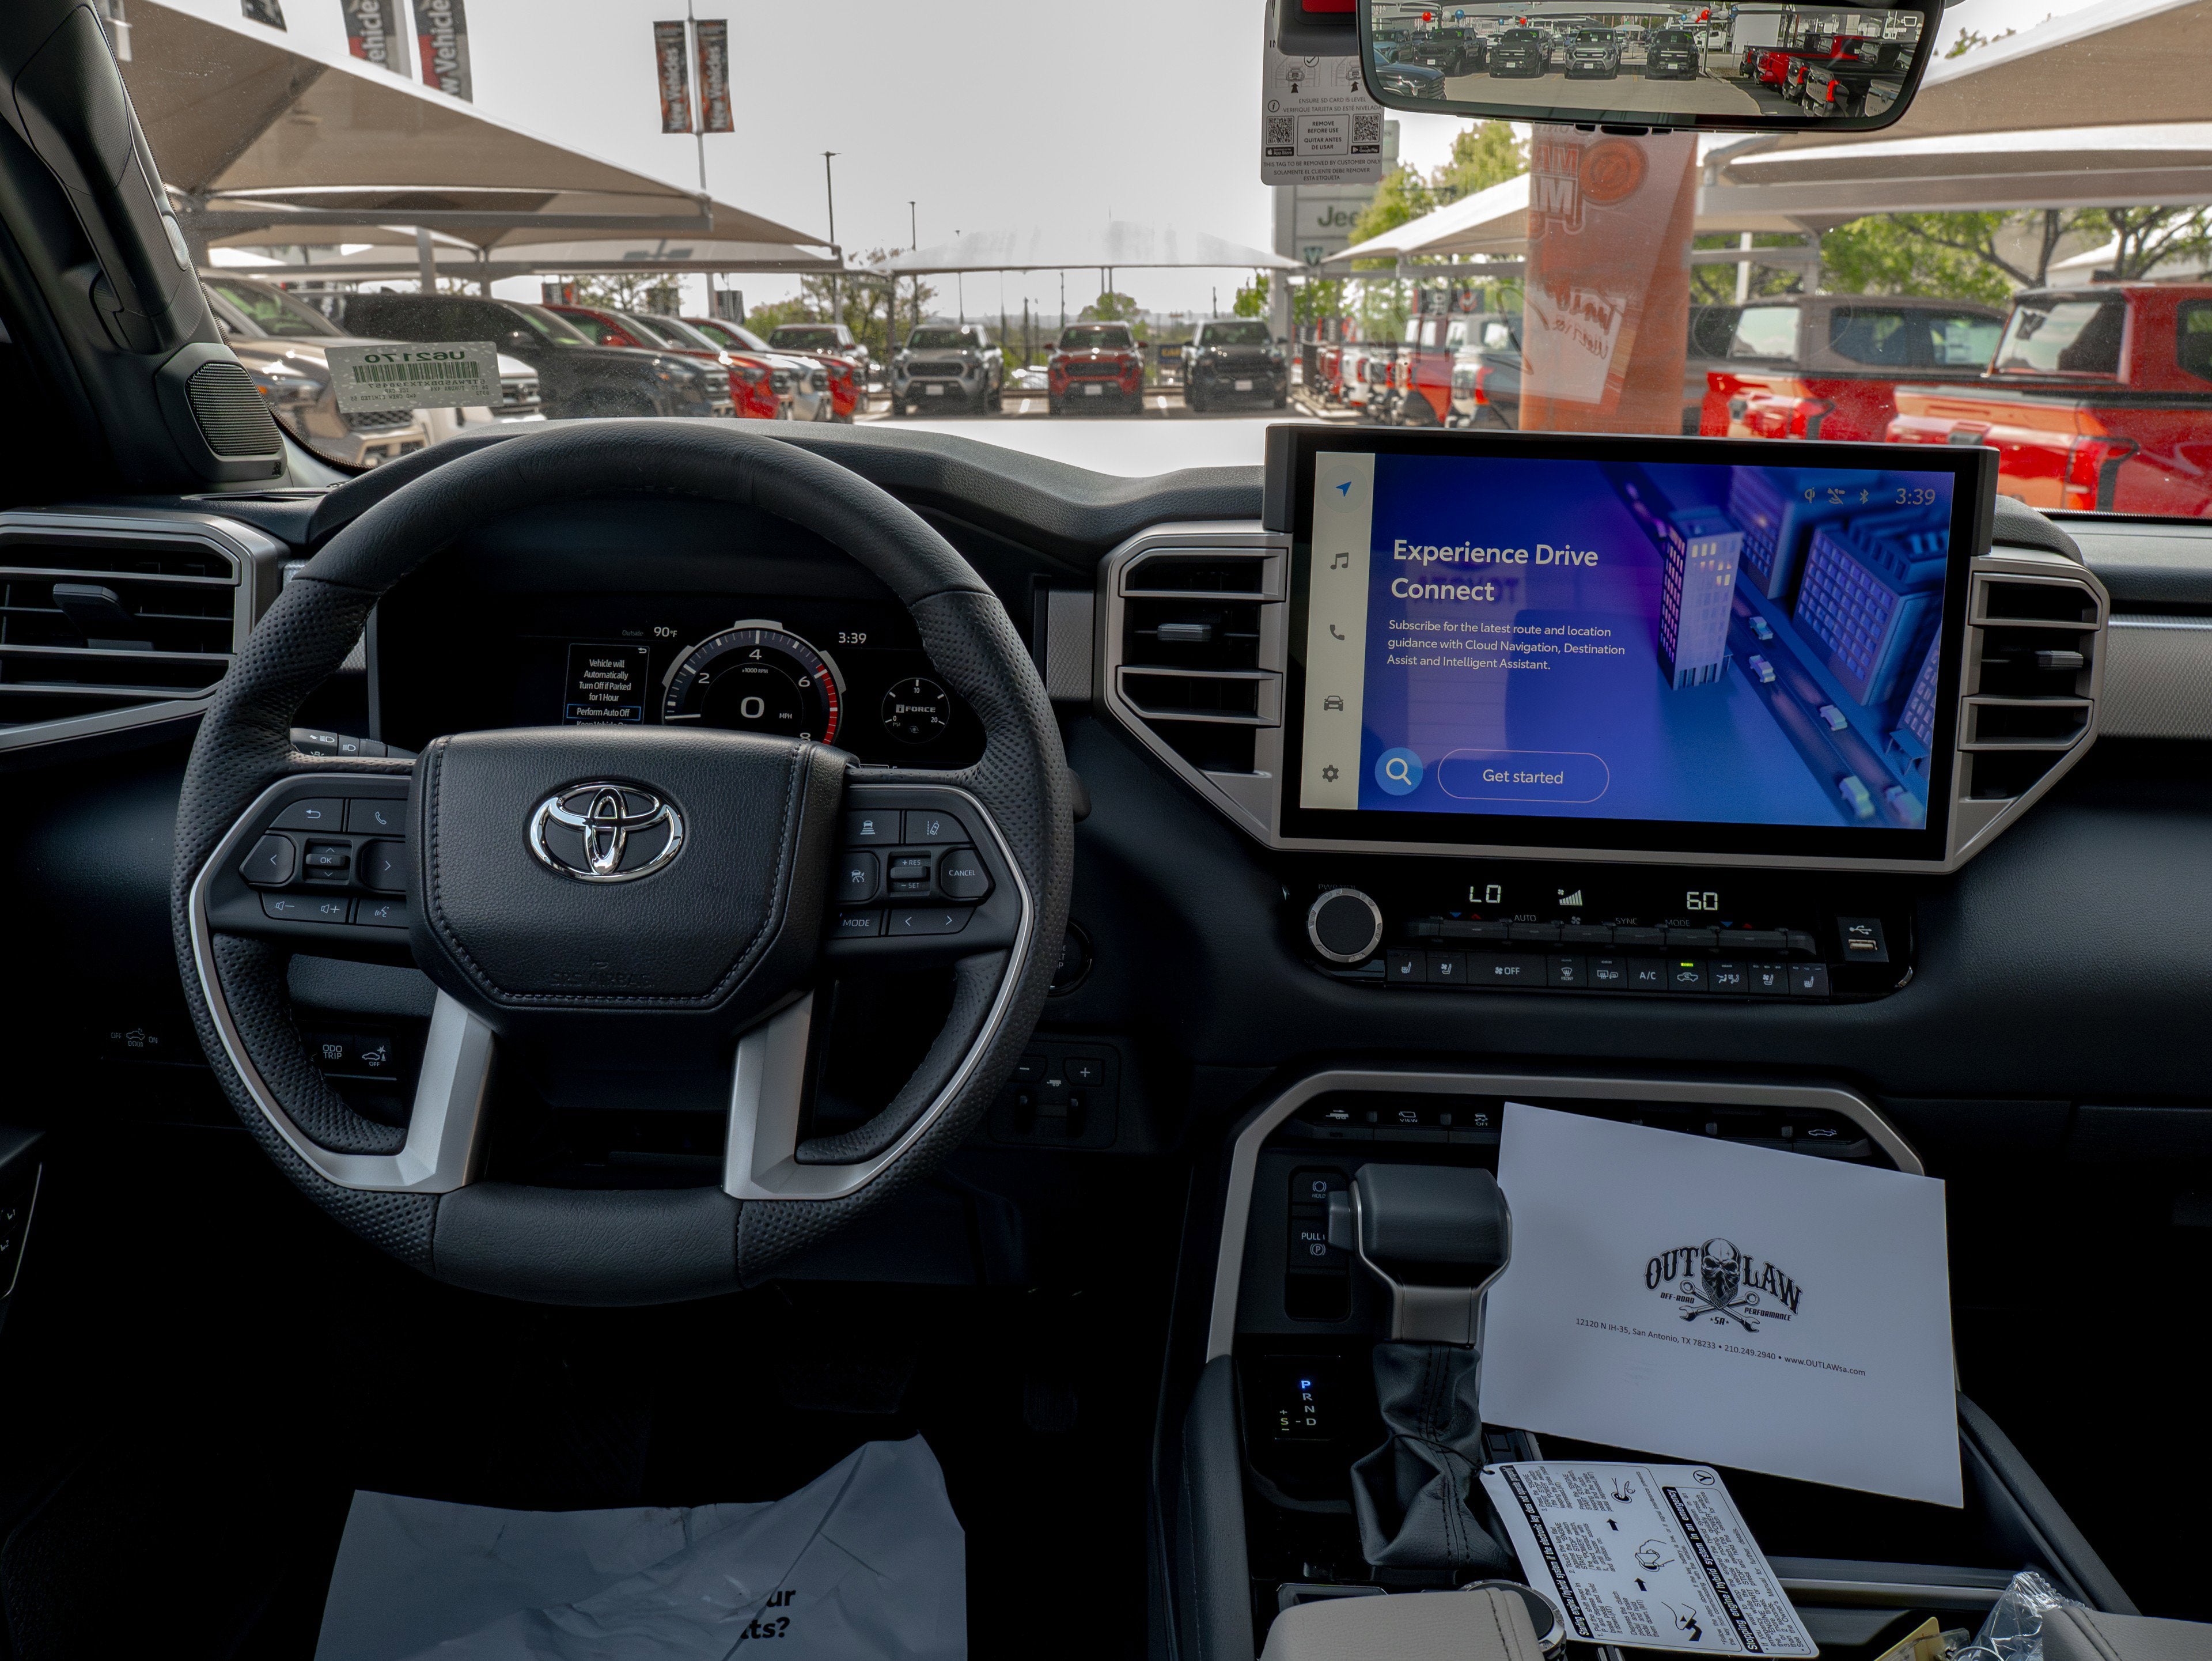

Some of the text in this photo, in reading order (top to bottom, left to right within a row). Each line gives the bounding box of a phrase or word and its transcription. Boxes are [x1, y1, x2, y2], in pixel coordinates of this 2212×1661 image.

[358, 0, 387, 68] ehicle
[1895, 487, 1936, 506] 3:39
[1393, 539, 1599, 566] Experience Drive
[1391, 577, 1495, 601] Connect
[1388, 619, 1612, 637] Subscribe for the latest route and location
[838, 632, 867, 644] 3:39
[1388, 637, 1626, 655] guidance with Cloud Navigation, Destination
[748, 649, 762, 660] 4
[589, 659, 625, 668] Vehicle will
[1387, 655, 1551, 671] Assist and Intelligent Assistant.
[584, 670, 628, 681] Automatically
[698, 672, 710, 684] 2
[578, 681, 593, 690] Turn
[594, 682, 605, 690] Off
[609, 682, 632, 691] Parked
[798, 676, 810, 687] 6
[589, 692, 598, 701] for
[603, 693, 620, 702] Hour
[577, 707, 630, 717] Perform Auto Off
[740, 696, 765, 718] 0
[1482, 769, 1564, 784] Get started
[1686, 891, 1718, 911] 60
[843, 919, 870, 927] MODE
[1514, 914, 1537, 922] AUTO
[1615, 917, 1638, 925] SYNC
[1665, 918, 1691, 927] MODE
[1504, 967, 1520, 975] OFF
[1639, 971, 1656, 980] A/C
[322, 1044, 343, 1052] ODO
[322, 1051, 342, 1060] TRIP
[1301, 1232, 1321, 1240] PULL
[1660, 1292, 1694, 1304] OFF-ROAD
[1744, 1307, 1791, 1321] PERFORMANCE
[1576, 1318, 1599, 1328] 12120
[1608, 1325, 1630, 1335] IH-35,
[1633, 1328, 1646, 1337] San
[1647, 1330, 1679, 1343] Antonio,
[1681, 1337, 1691, 1345] TX
[1693, 1338, 1715, 1349] 78233
[1725, 1344, 1776, 1360] 210.249.2940
[1784, 1356, 1866, 1376] www.OUTLAWsa.com
[1301, 1380, 1311, 1388] P
[1302, 1393, 1313, 1401] R
[1304, 1405, 1315, 1413] N
[1280, 1417, 1289, 1425] S
[1306, 1418, 1317, 1426] D
[1524, 1503, 1535, 1514] does
[1666, 1489, 1689, 1520] emergency
[1529, 1514, 1540, 1523] key
[1685, 1523, 1695, 1531] an
[1532, 1523, 1550, 1546] electronic
[1543, 1546, 1554, 1554] the
[1695, 1542, 1713, 1565] system
[1550, 1561, 1565, 1579] system
[1574, 1616, 1589, 1636] Starting
[1735, 1619, 1758, 1650] Stopping
